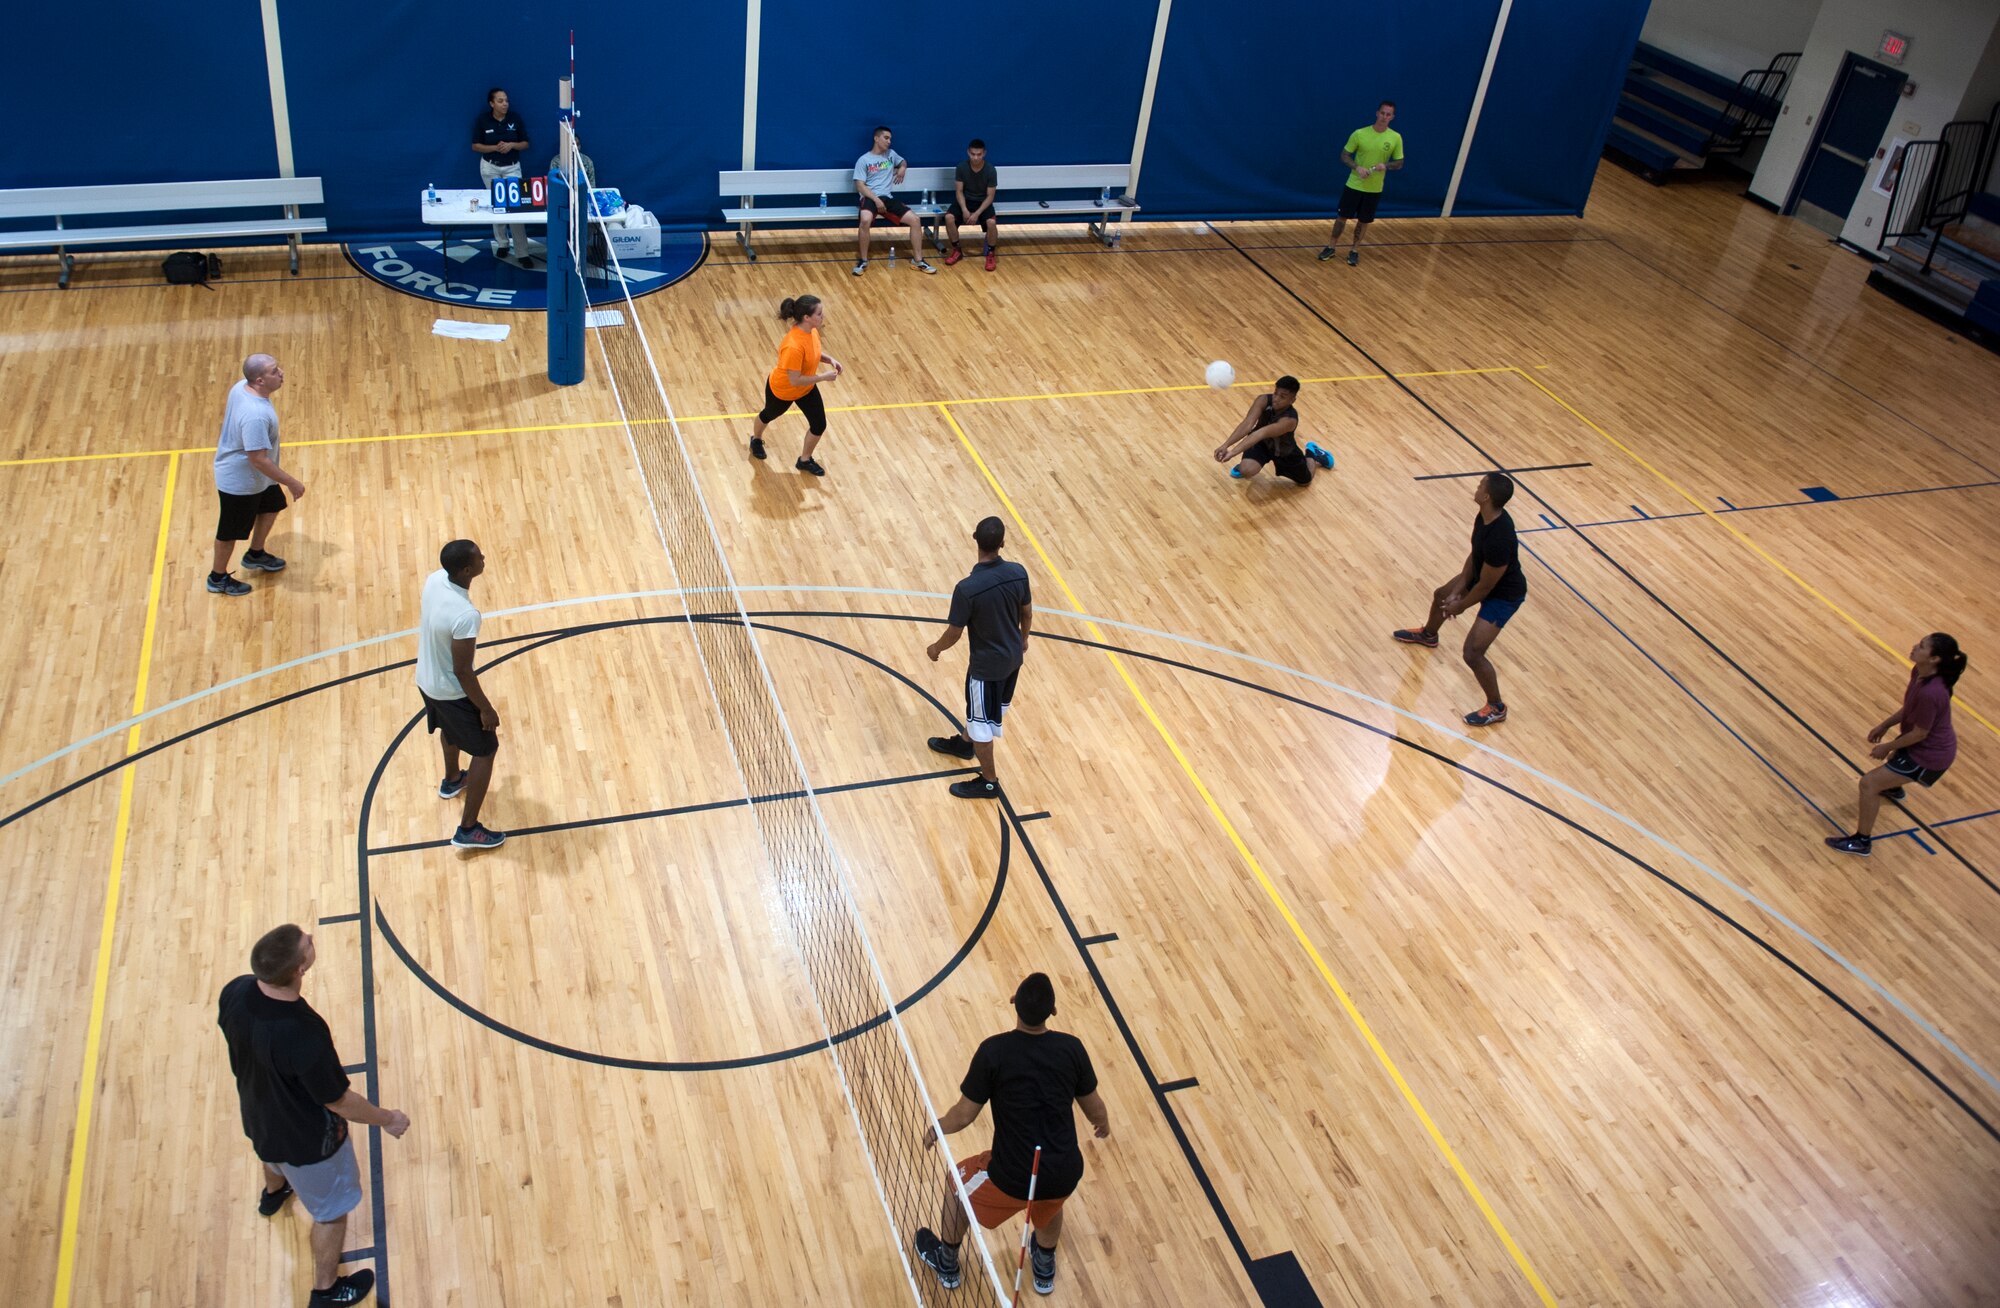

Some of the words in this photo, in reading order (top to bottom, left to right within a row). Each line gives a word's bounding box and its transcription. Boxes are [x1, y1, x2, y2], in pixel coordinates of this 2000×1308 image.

[1883, 37, 1905, 55] EXIT
[494, 181, 520, 204] 06
[532, 180, 548, 202] 0
[358, 245, 517, 305] FORCE
